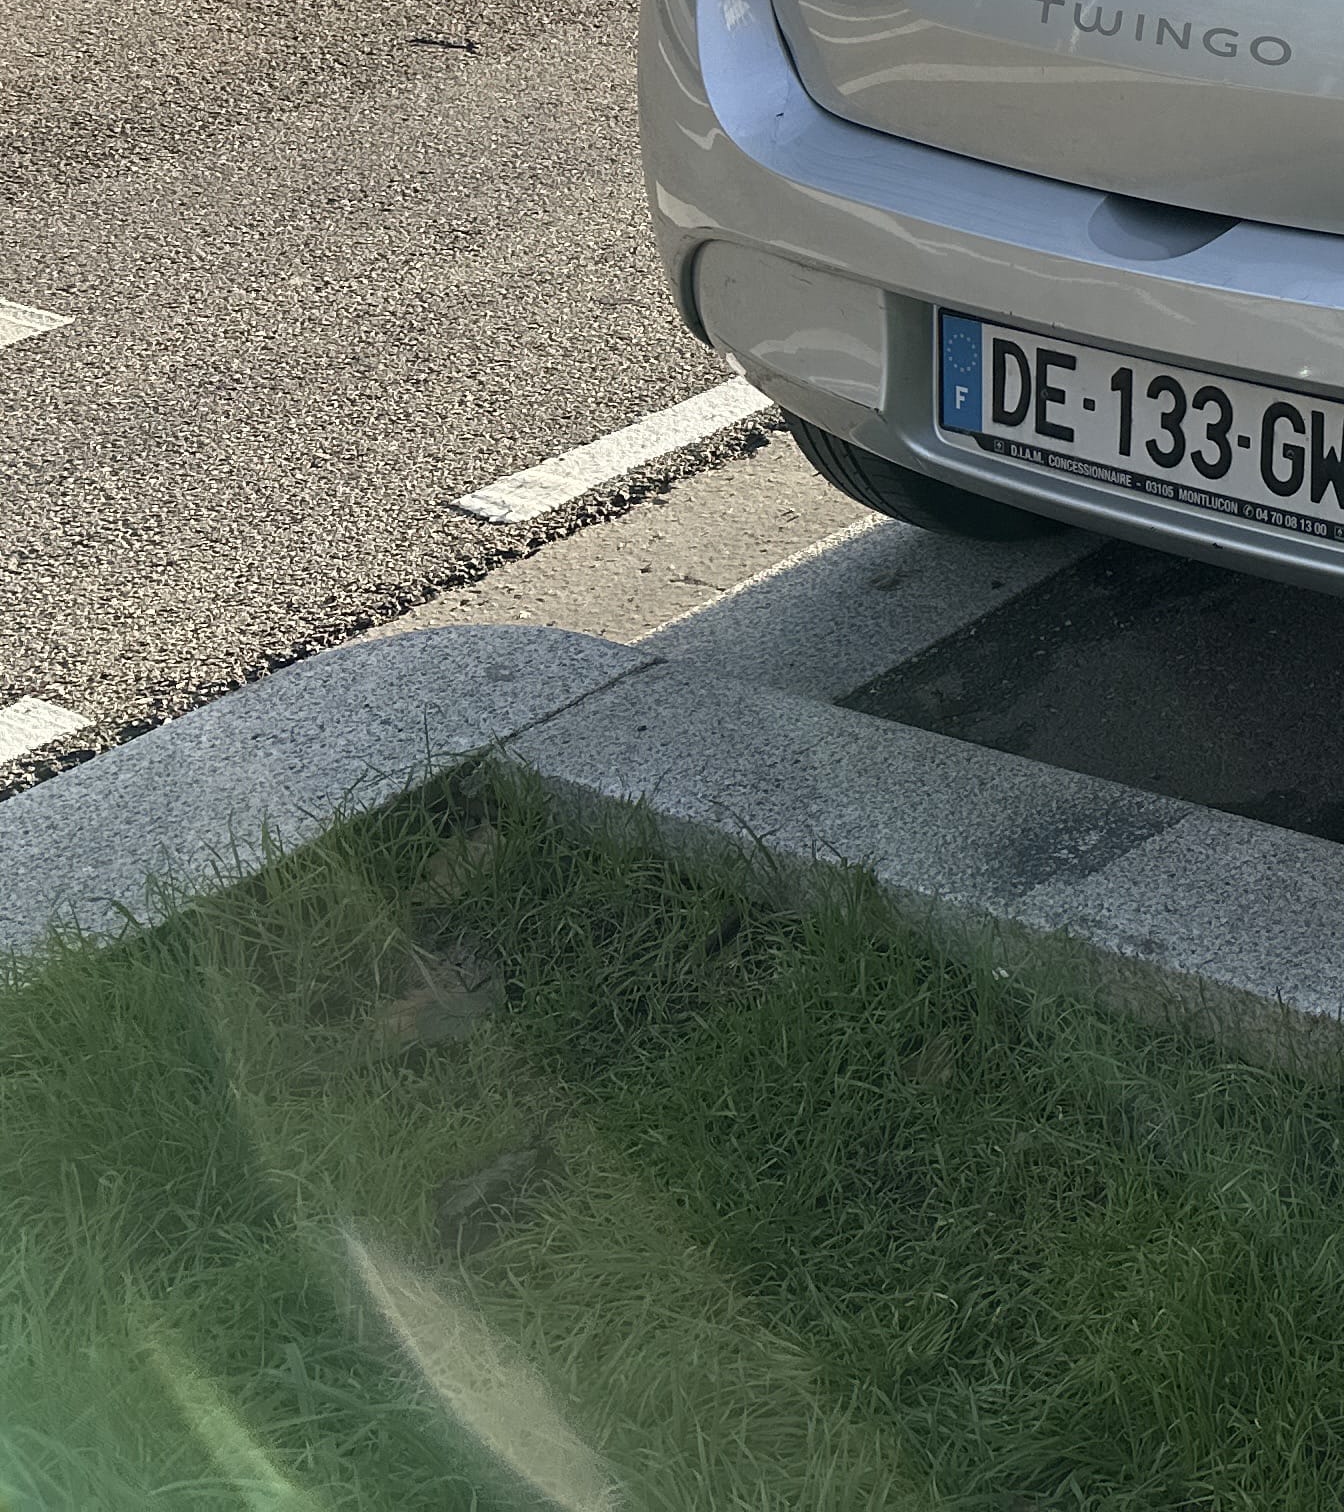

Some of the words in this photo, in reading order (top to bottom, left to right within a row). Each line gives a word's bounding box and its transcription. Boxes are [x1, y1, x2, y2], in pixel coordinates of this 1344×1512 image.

[954, 384, 970, 411] F
[1010, 444, 1045, 464] D.I.A.M.
[1048, 454, 1133, 487] CONCESSIONNAIRE
[1145, 479, 1174, 498] 03105
[1178, 488, 1239, 514] MONTLUCON
[1255, 509, 1269, 522] 04
[1270, 511, 1284, 525] 70
[1299, 518, 1313, 533] 13
[1313, 523, 1328, 536] 00
